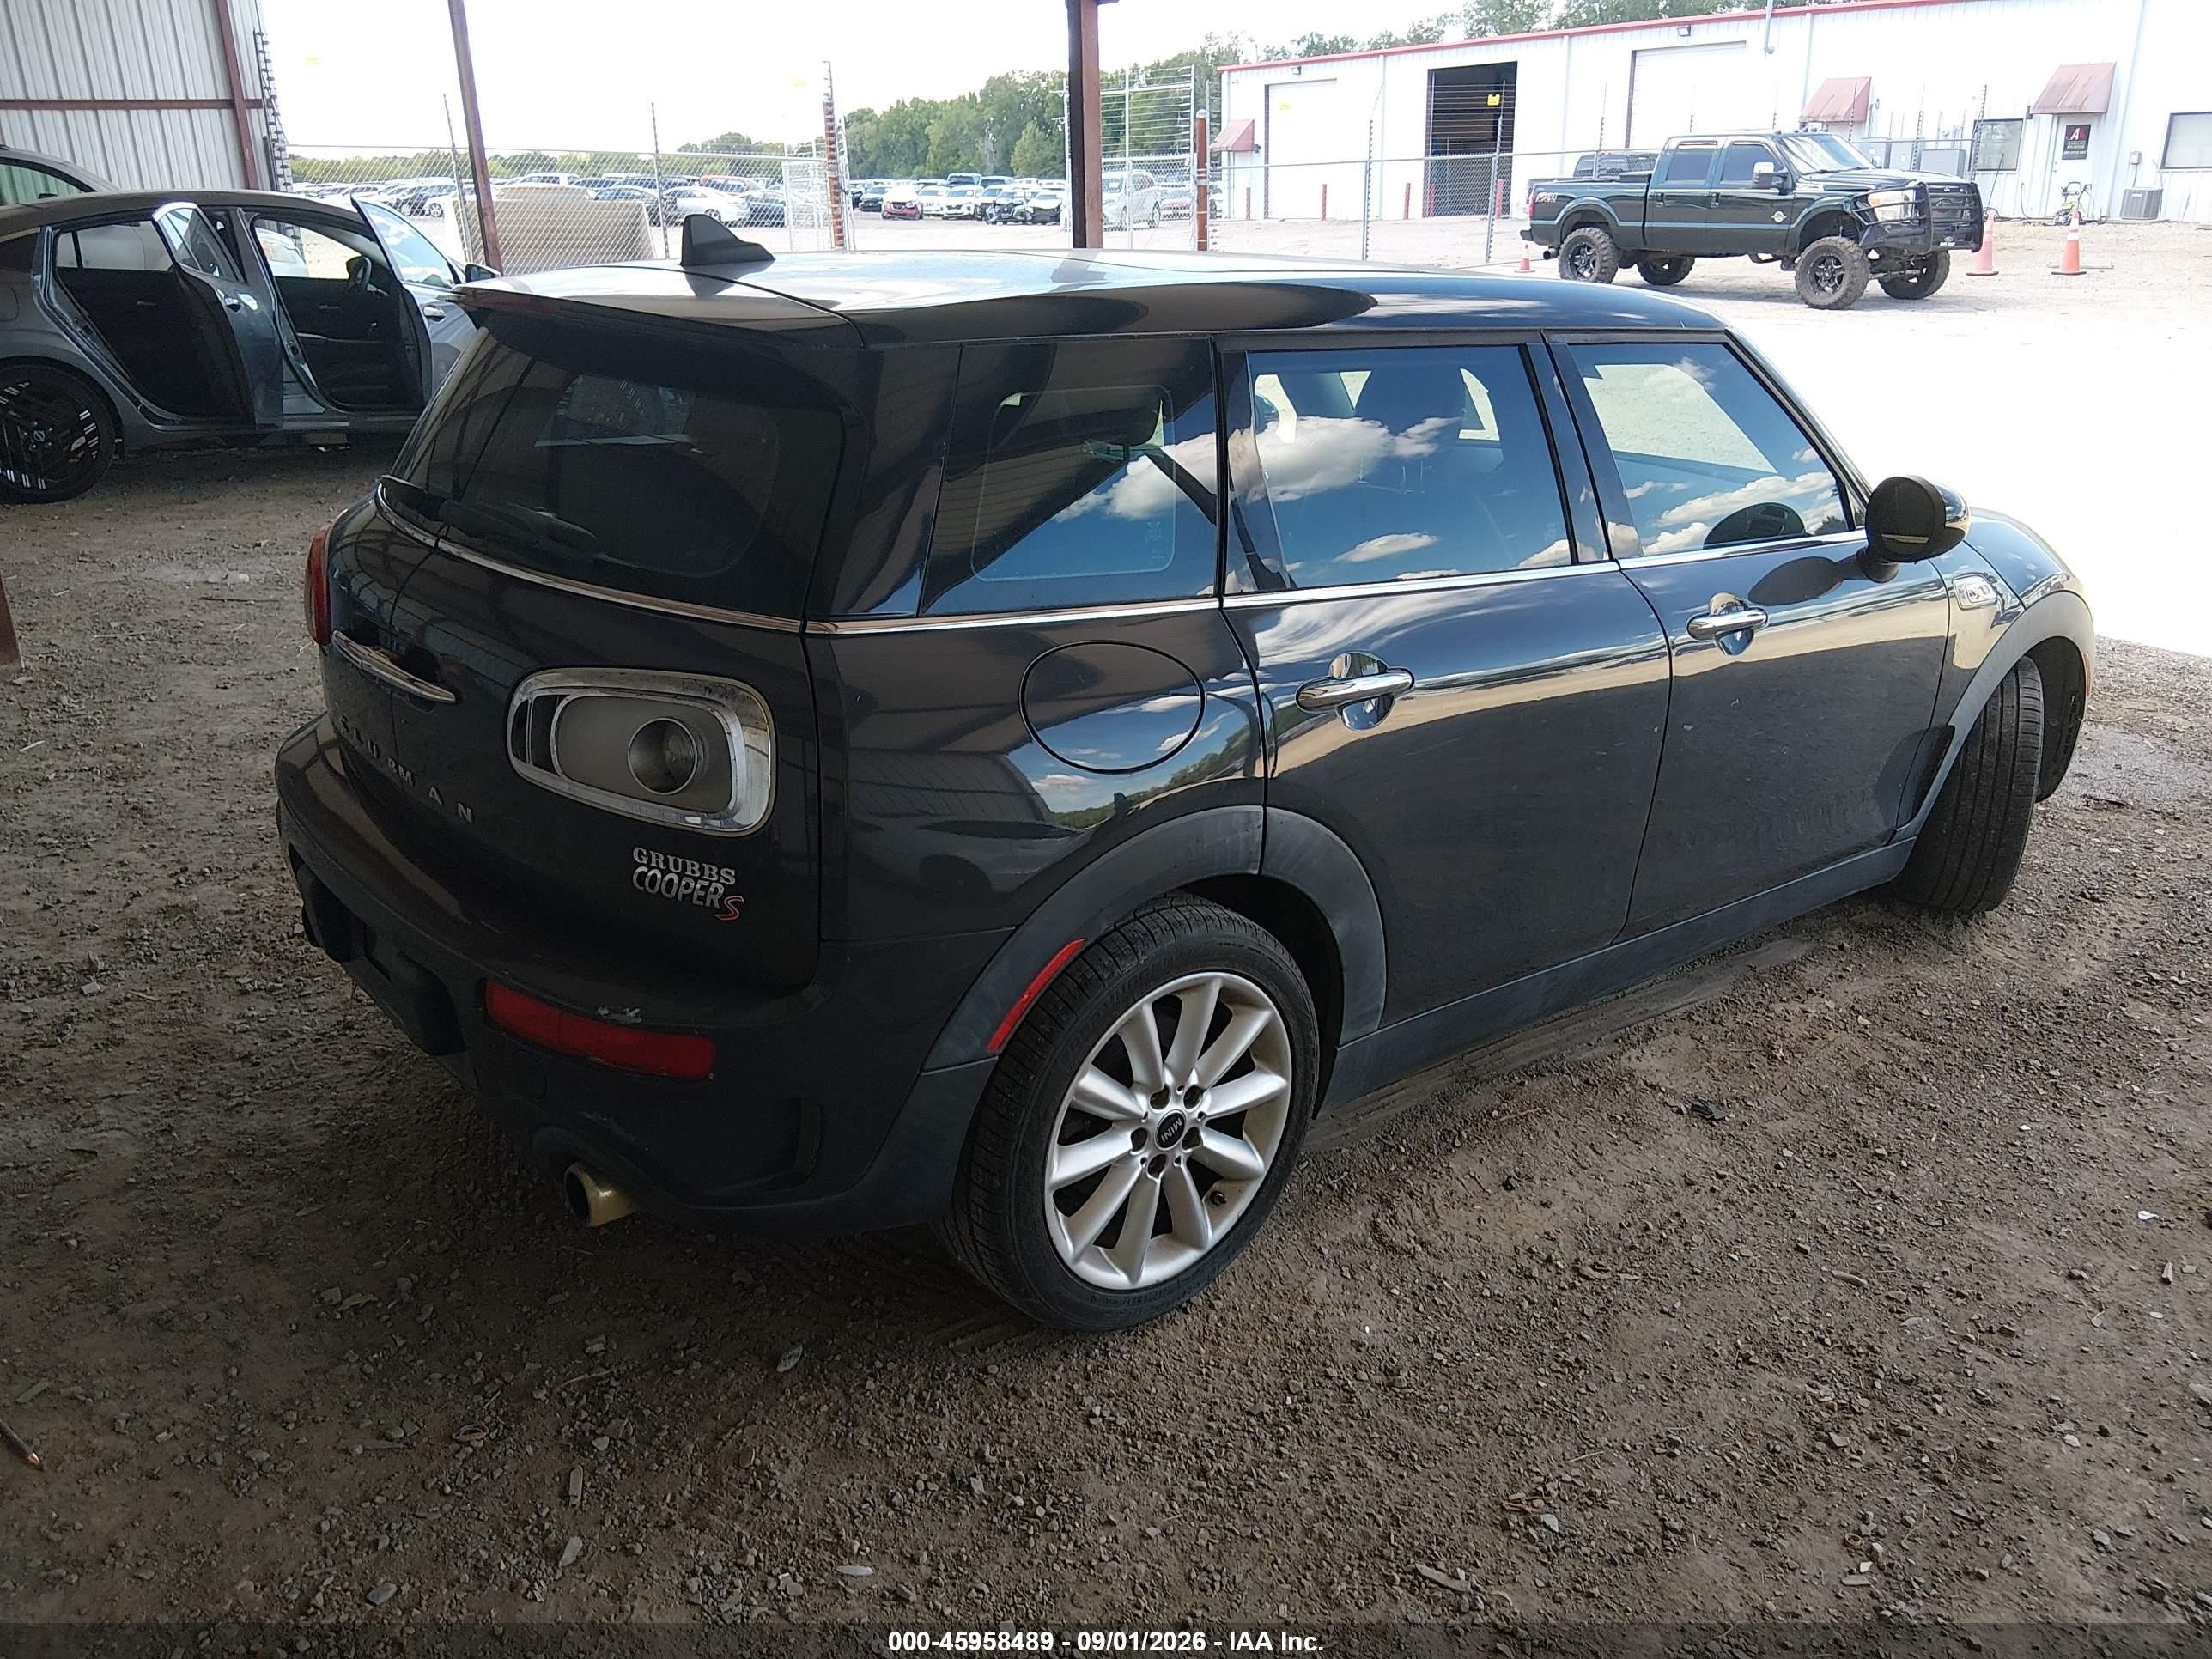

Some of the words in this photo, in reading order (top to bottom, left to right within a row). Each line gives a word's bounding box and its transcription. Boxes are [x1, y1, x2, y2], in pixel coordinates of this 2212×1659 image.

[632, 846, 737, 885] GRUBBS
[632, 866, 725, 909] COOPER
[714, 895, 744, 921] S
[1160, 1117, 1182, 1143] MINI
